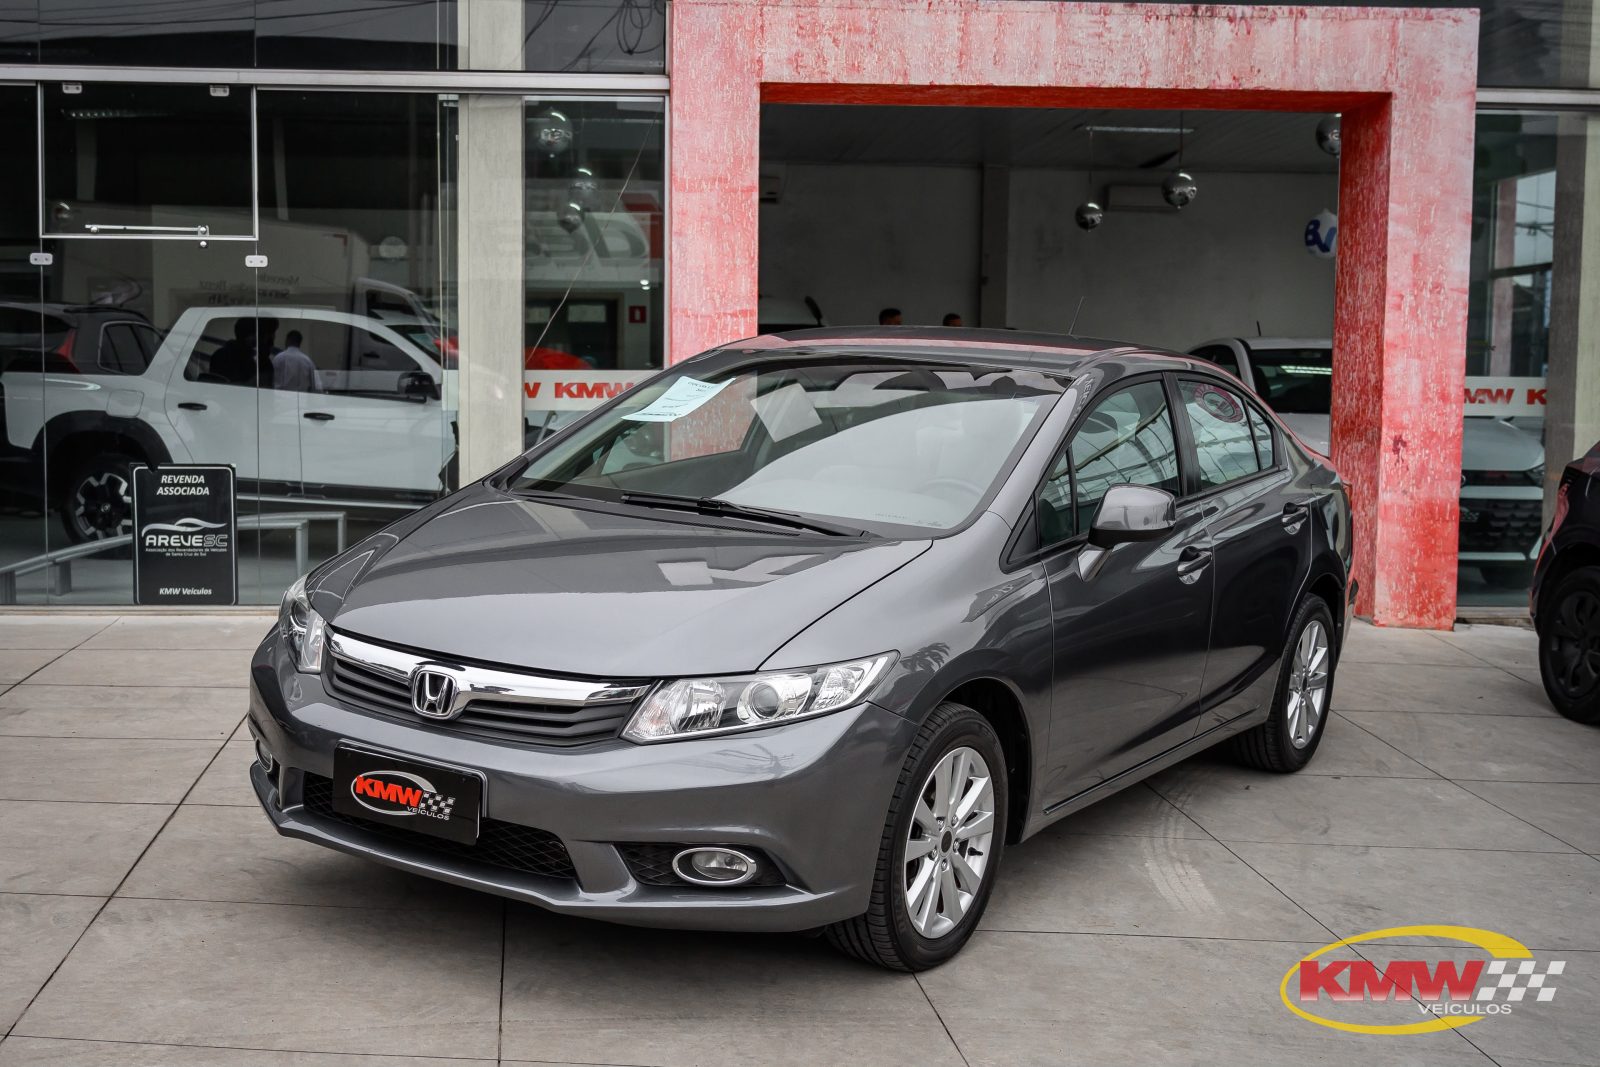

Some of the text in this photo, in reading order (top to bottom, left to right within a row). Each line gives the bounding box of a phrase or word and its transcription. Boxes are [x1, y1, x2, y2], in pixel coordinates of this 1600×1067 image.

[554, 382, 634, 399] KMW
[1463, 388, 1515, 404] MW
[161, 475, 205, 484] REVENDA
[156, 486, 210, 496] ASSOCIADA
[145, 534, 228, 547] AREVESC
[159, 587, 212, 595] KMW Veículos
[355, 775, 422, 807] KMW
[406, 805, 450, 821] VEÍCULOS
